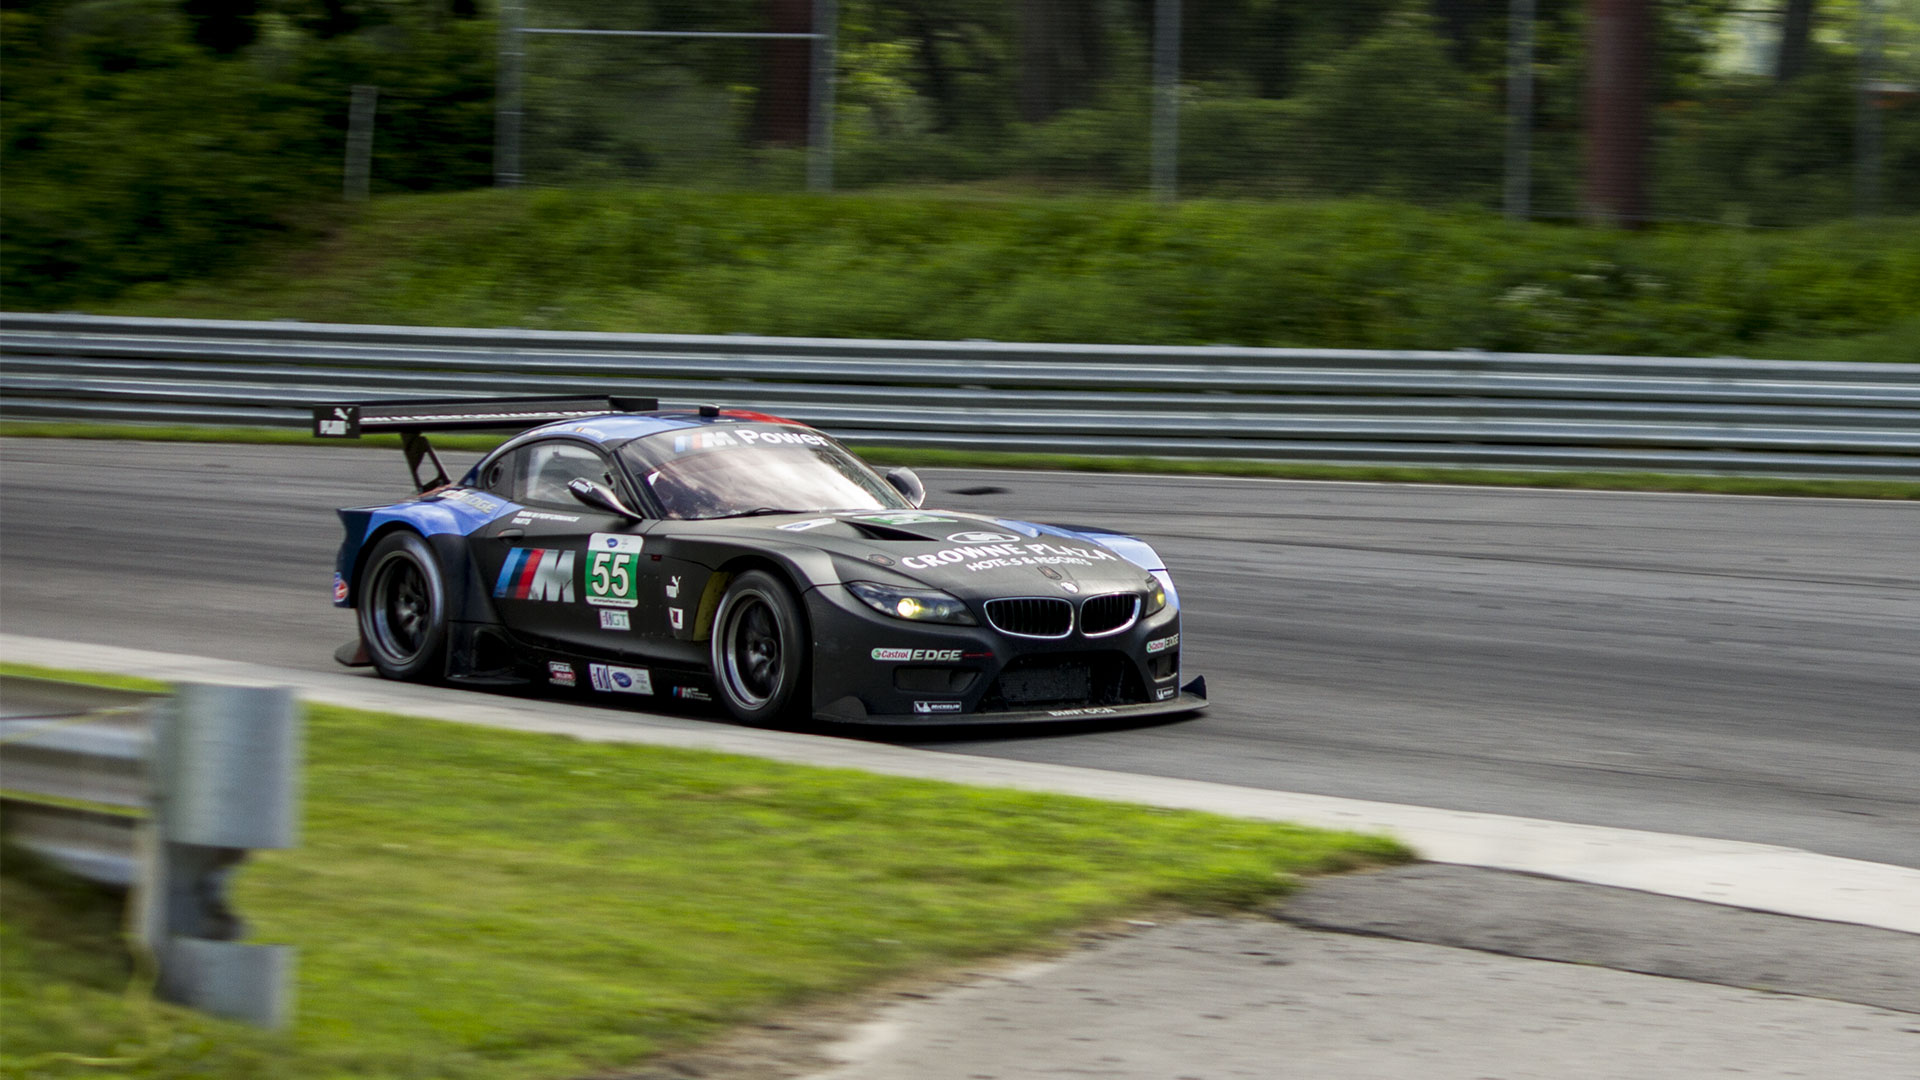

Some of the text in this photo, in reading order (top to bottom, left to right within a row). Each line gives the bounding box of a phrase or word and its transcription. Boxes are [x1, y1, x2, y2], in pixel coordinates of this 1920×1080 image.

[735, 429, 829, 447] Power
[901, 543, 1118, 570] CROWNE PLAZA
[966, 557, 1023, 572] HOTELS
[591, 552, 631, 597] 55
[881, 649, 963, 661] Castrol EDGE
